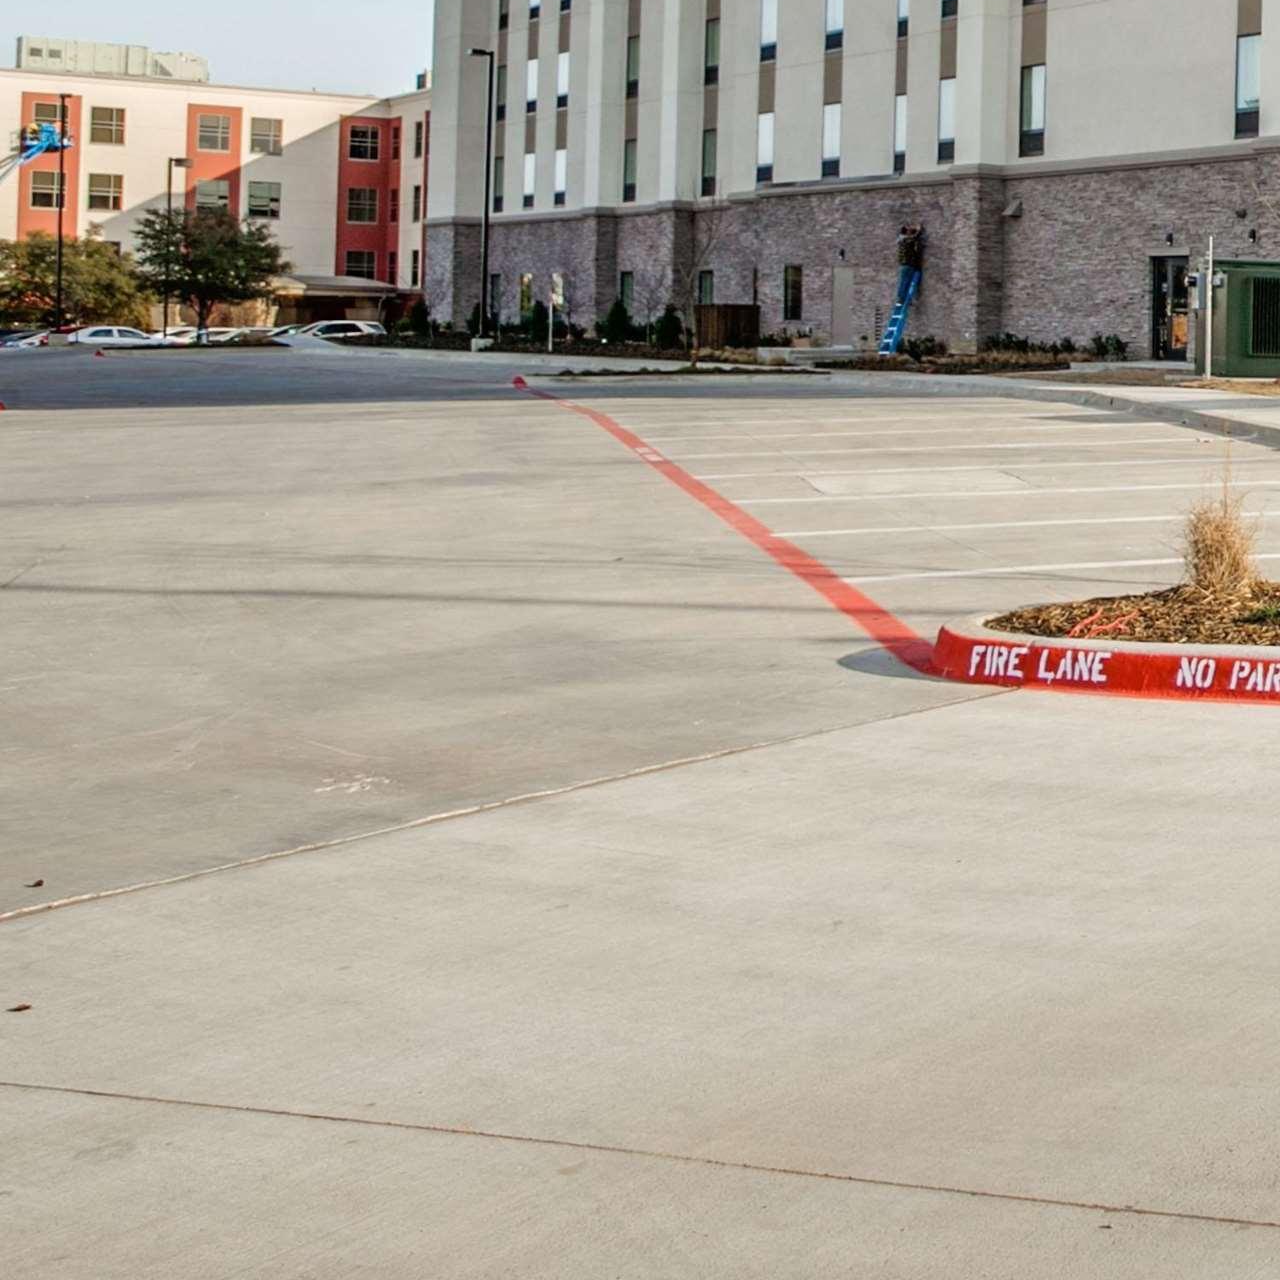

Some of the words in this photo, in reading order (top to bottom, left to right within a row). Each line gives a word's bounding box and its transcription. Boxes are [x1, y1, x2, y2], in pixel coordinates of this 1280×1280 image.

[968, 644, 1029, 678] FIRE
[1037, 648, 1112, 683] LANE
[1175, 655, 1216, 689] NO
